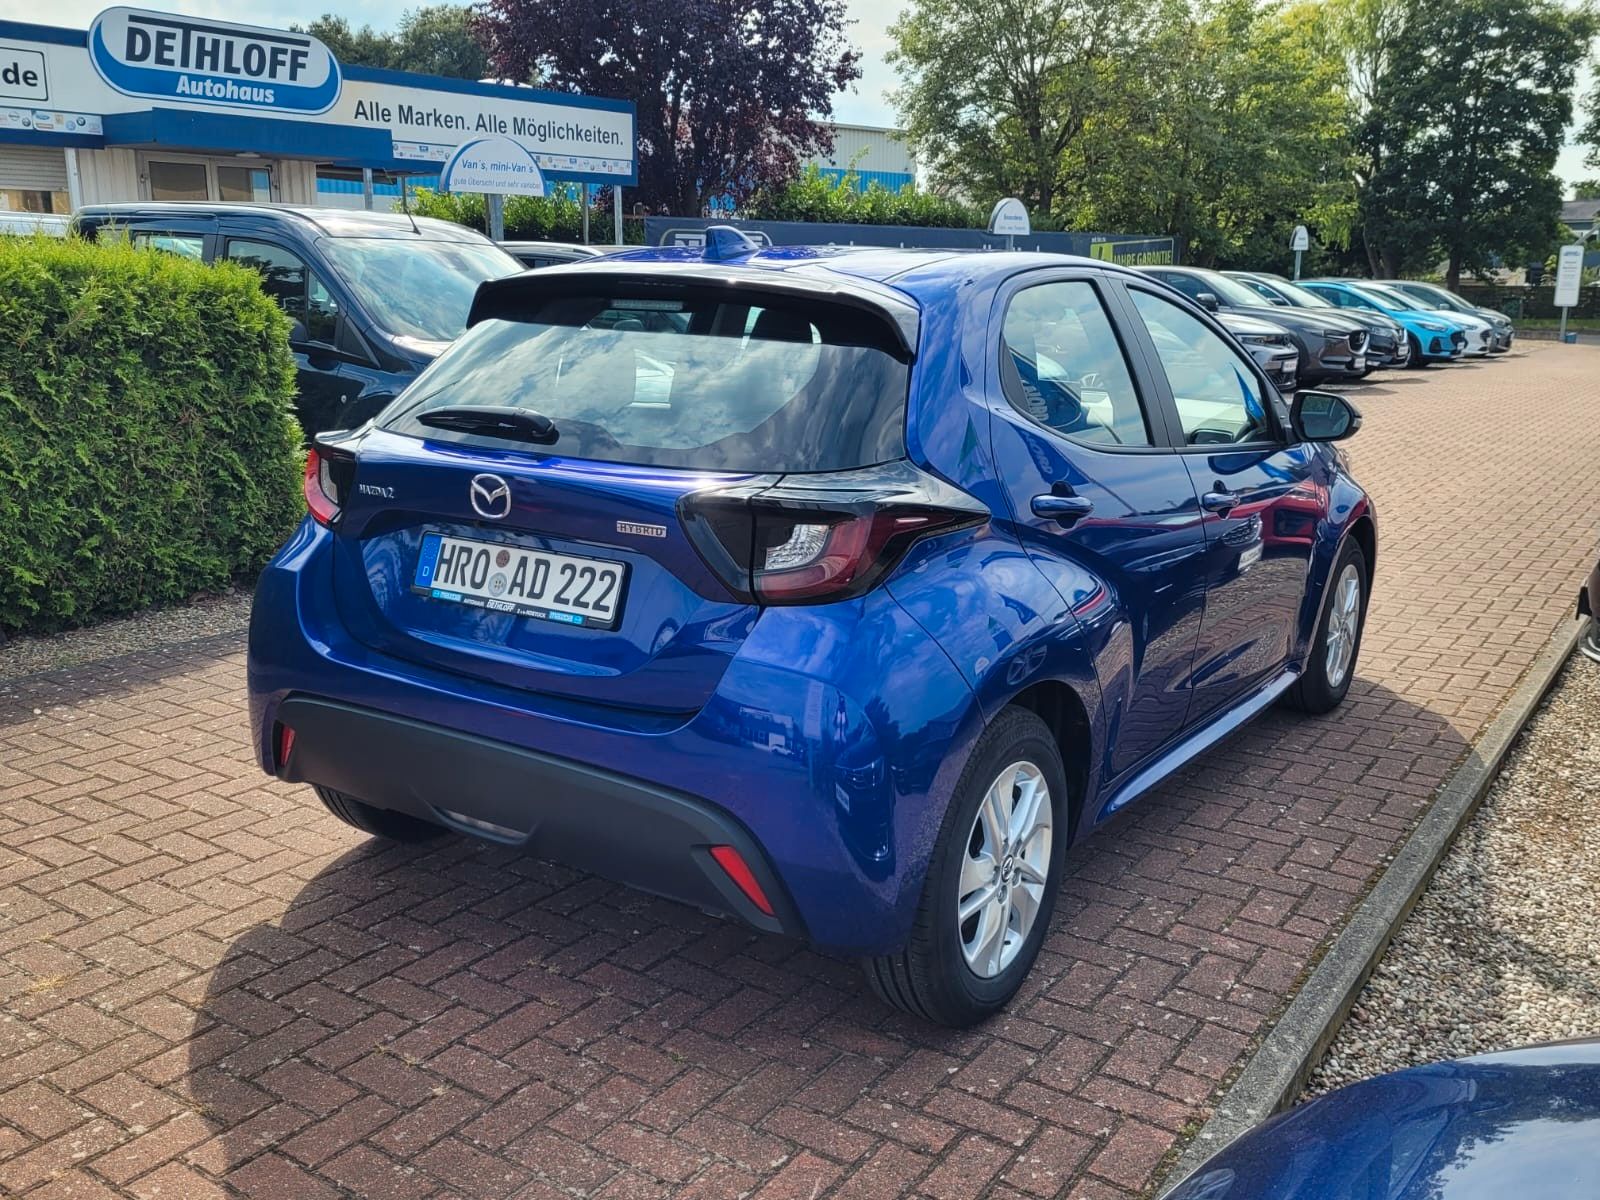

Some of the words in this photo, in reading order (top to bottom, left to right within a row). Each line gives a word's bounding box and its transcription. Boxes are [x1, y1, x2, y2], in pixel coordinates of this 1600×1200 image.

[125, 14, 312, 82] DETHLOFF
[2, 62, 38, 88] de
[176, 75, 275, 104] Autohaus
[354, 99, 392, 123] Alle
[398, 104, 471, 131] Marken.
[475, 113, 508, 135] Alle
[513, 117, 624, 146] Möglichkeiten.
[1137, 250, 1172, 265] GARANTIE
[618, 522, 664, 537] HYBRID
[422, 566, 429, 577] D
[433, 542, 491, 591] HRO
[508, 555, 551, 600] AD
[553, 563, 618, 613] 222
[486, 599, 516, 612] DETHLOFF
